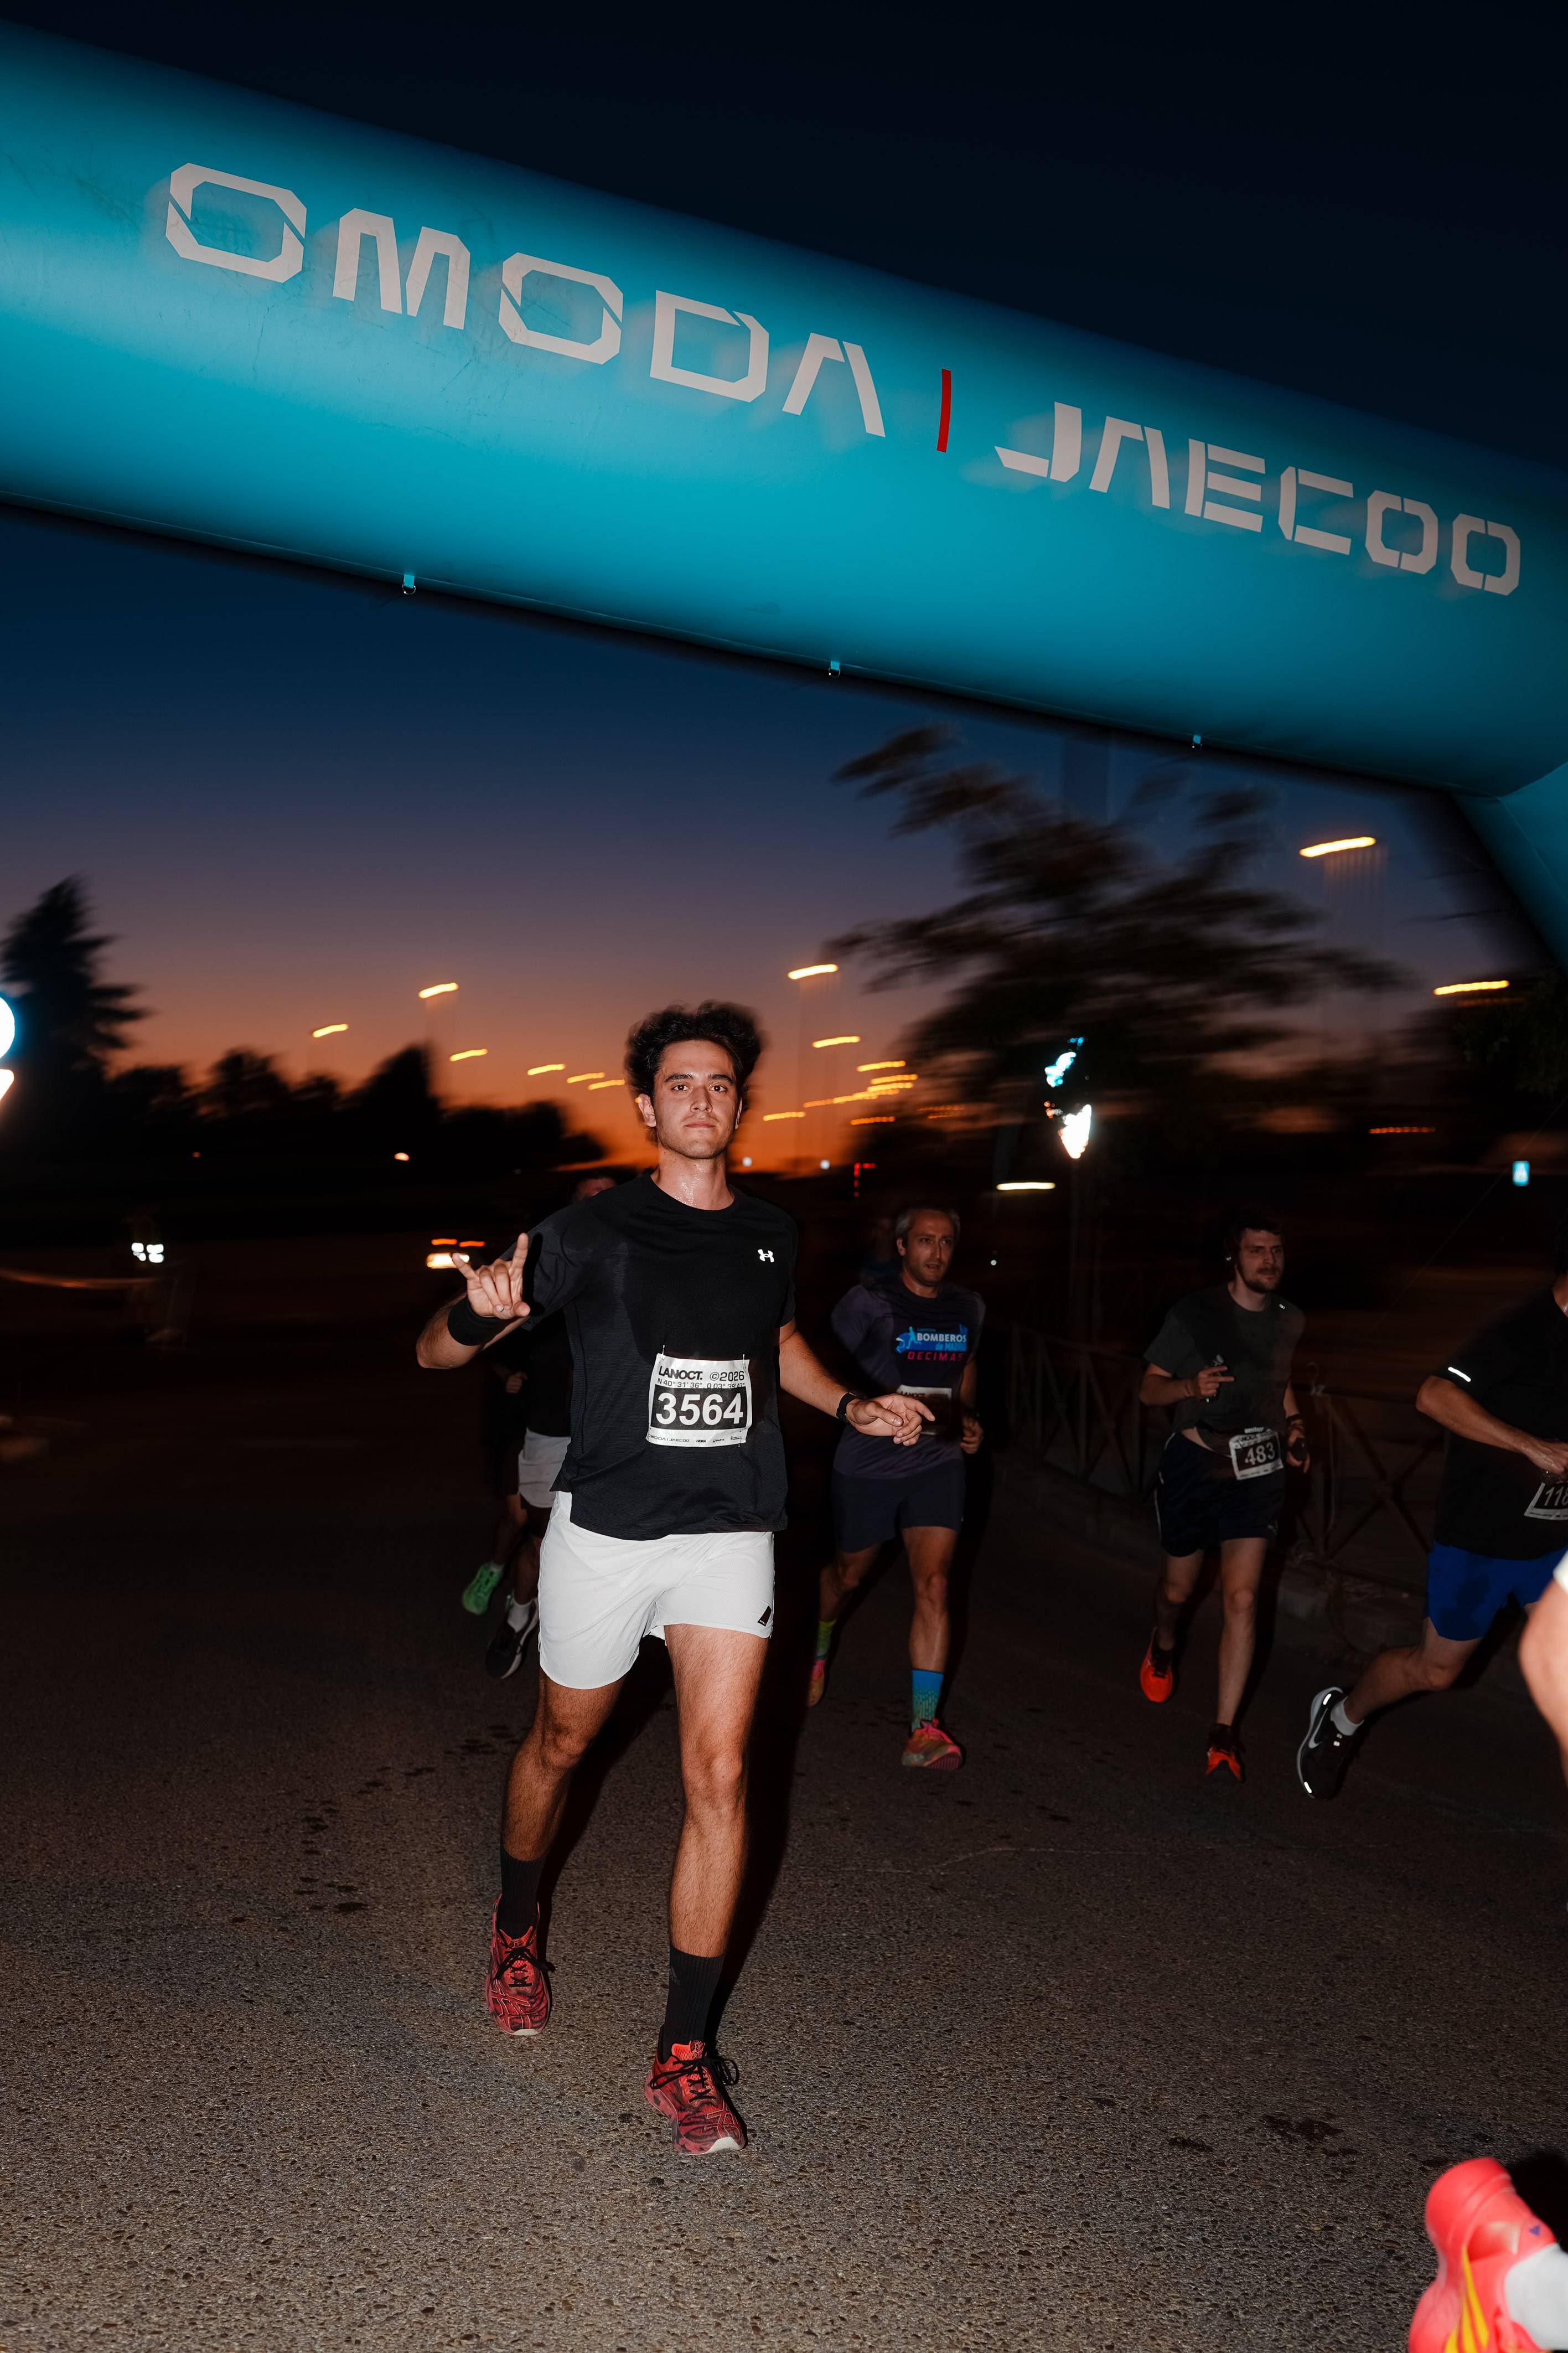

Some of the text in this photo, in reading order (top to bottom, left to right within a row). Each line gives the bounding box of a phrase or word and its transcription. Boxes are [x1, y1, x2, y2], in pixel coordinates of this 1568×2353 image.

[165, 163, 886, 437] OMODA
[995, 401, 1522, 596] JAECOO
[917, 1333, 967, 1343] BOMBEROS
[907, 1350, 964, 1361] DECIMAS
[655, 1392, 743, 1426] 3564
[1245, 1442, 1275, 1466] 483
